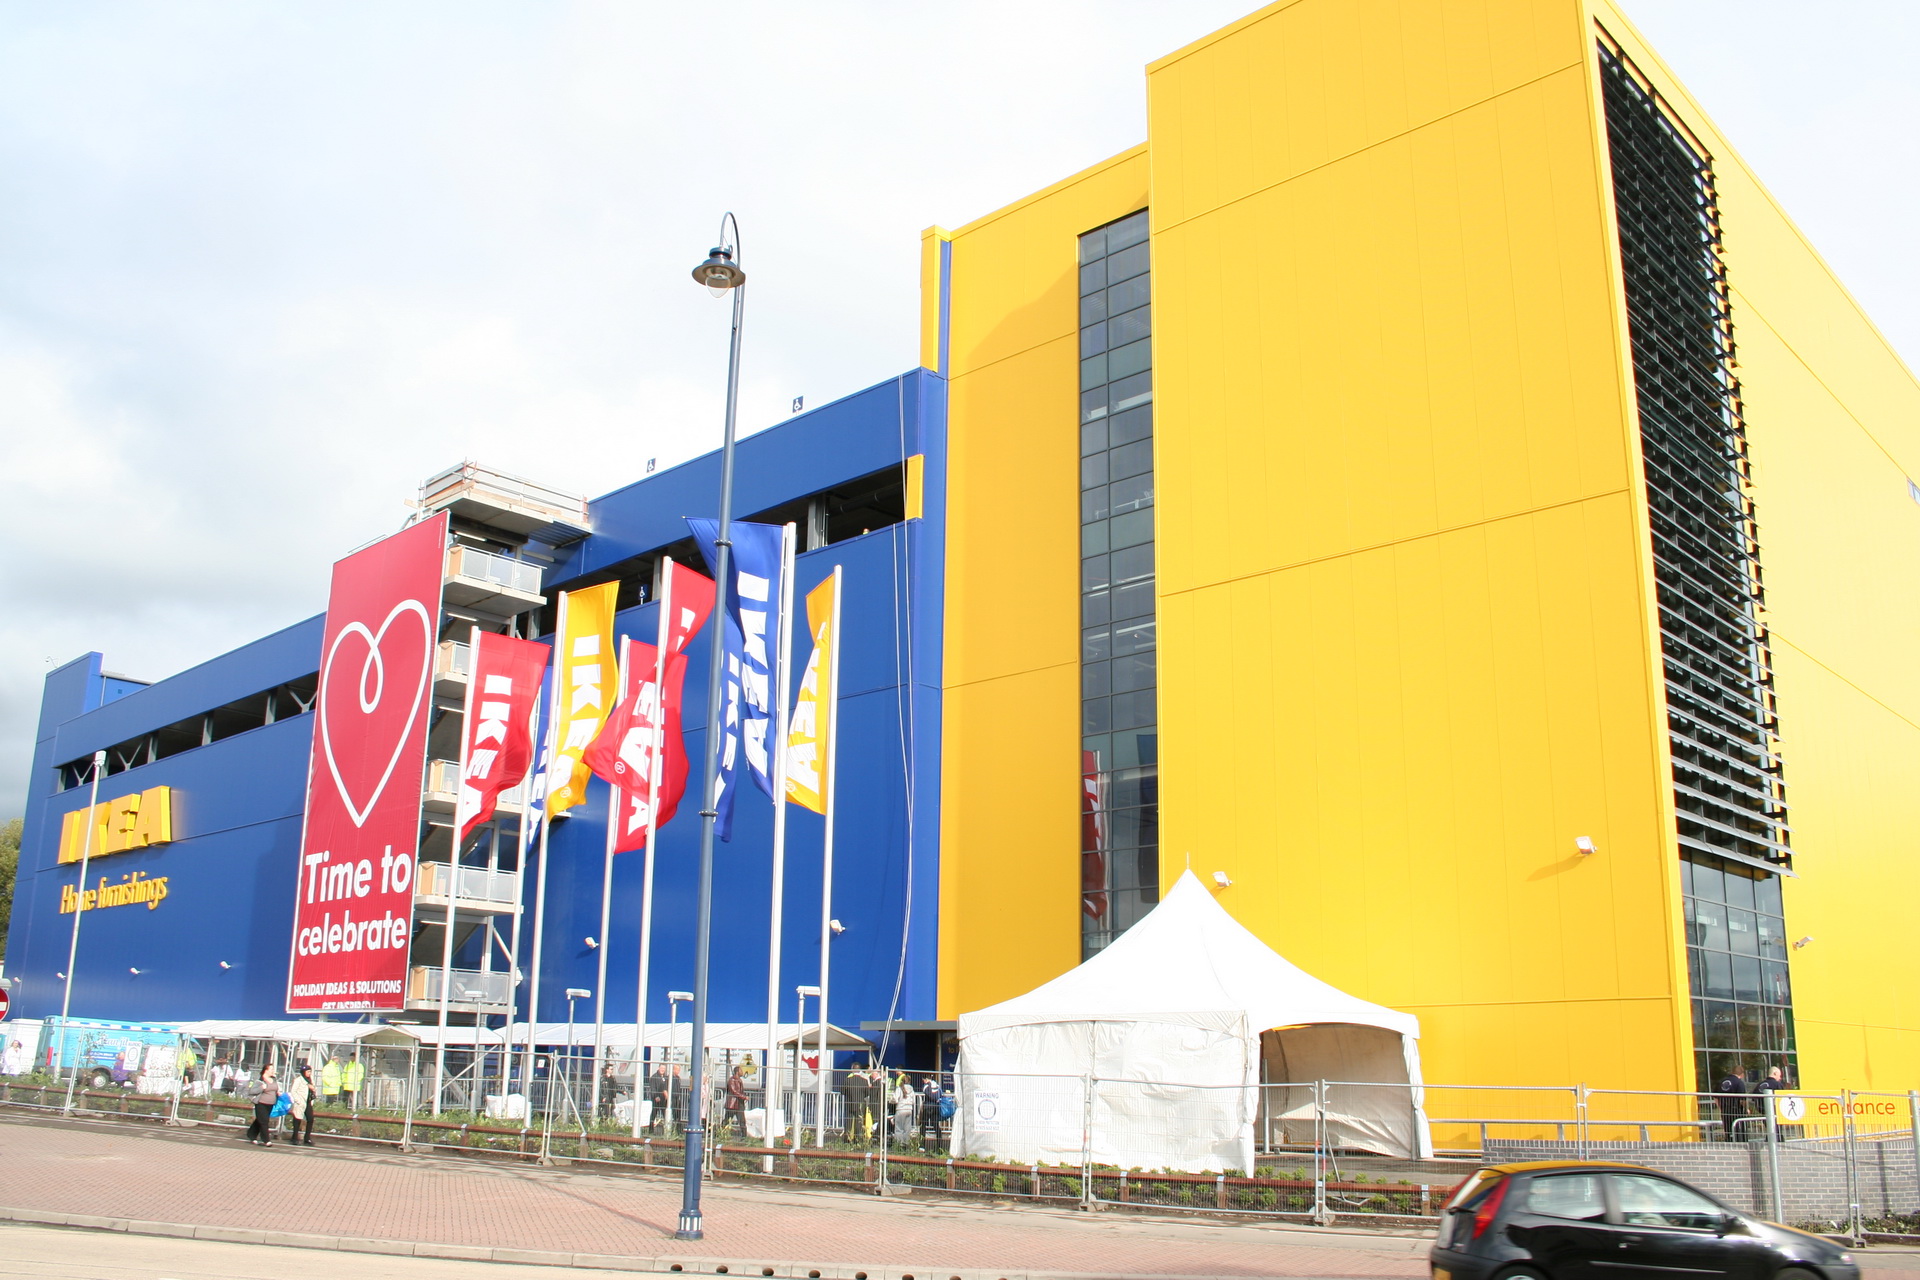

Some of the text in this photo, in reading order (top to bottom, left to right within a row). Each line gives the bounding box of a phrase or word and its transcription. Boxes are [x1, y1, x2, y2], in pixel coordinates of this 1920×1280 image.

[549, 634, 601, 794] IKEA
[58, 785, 172, 864] IKEA
[97, 871, 169, 910] furnishings
[305, 845, 412, 904] Time to
[299, 910, 407, 956] celebrate
[293, 980, 402, 997] HOLIDAY IDEAS & SOLUTIONS
[1818, 1102, 1895, 1115] enrance
